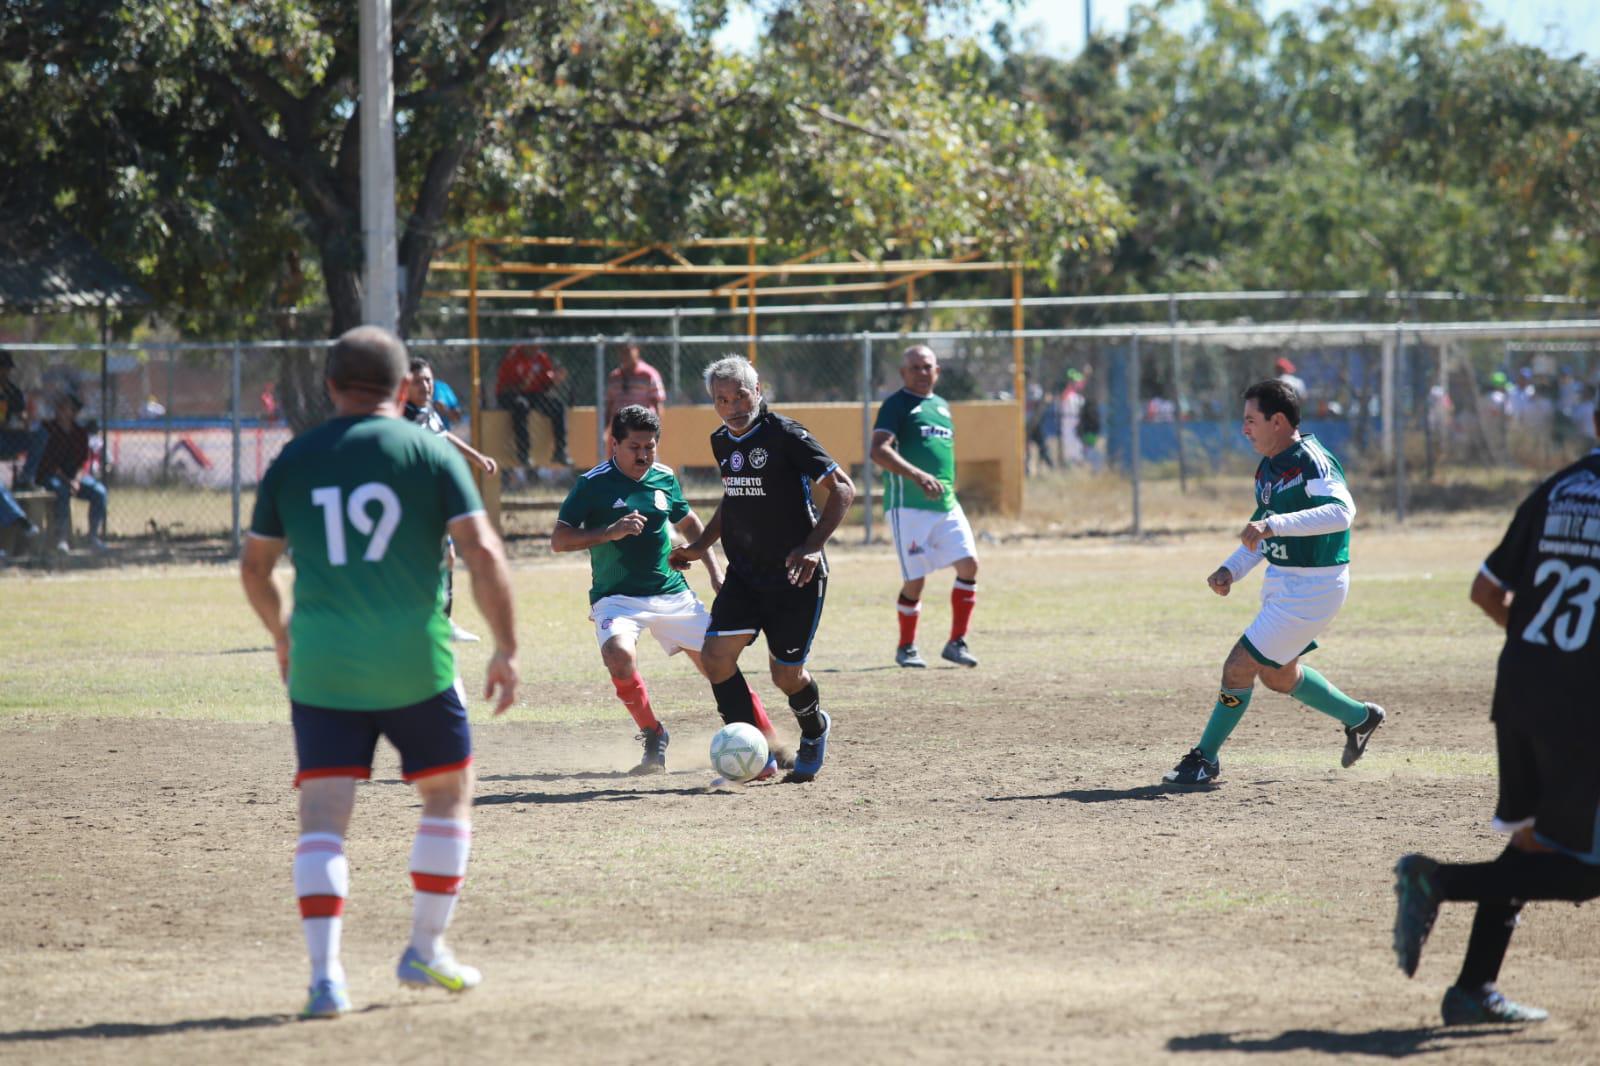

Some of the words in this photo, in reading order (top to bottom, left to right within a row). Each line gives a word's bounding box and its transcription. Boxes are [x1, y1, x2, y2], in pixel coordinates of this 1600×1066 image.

[726, 476, 762, 487] CEMENTO
[728, 487, 745, 496] CRUZ
[745, 487, 767, 496] AZUL
[311, 481, 402, 566] 19
[1522, 559, 1600, 652] 23
